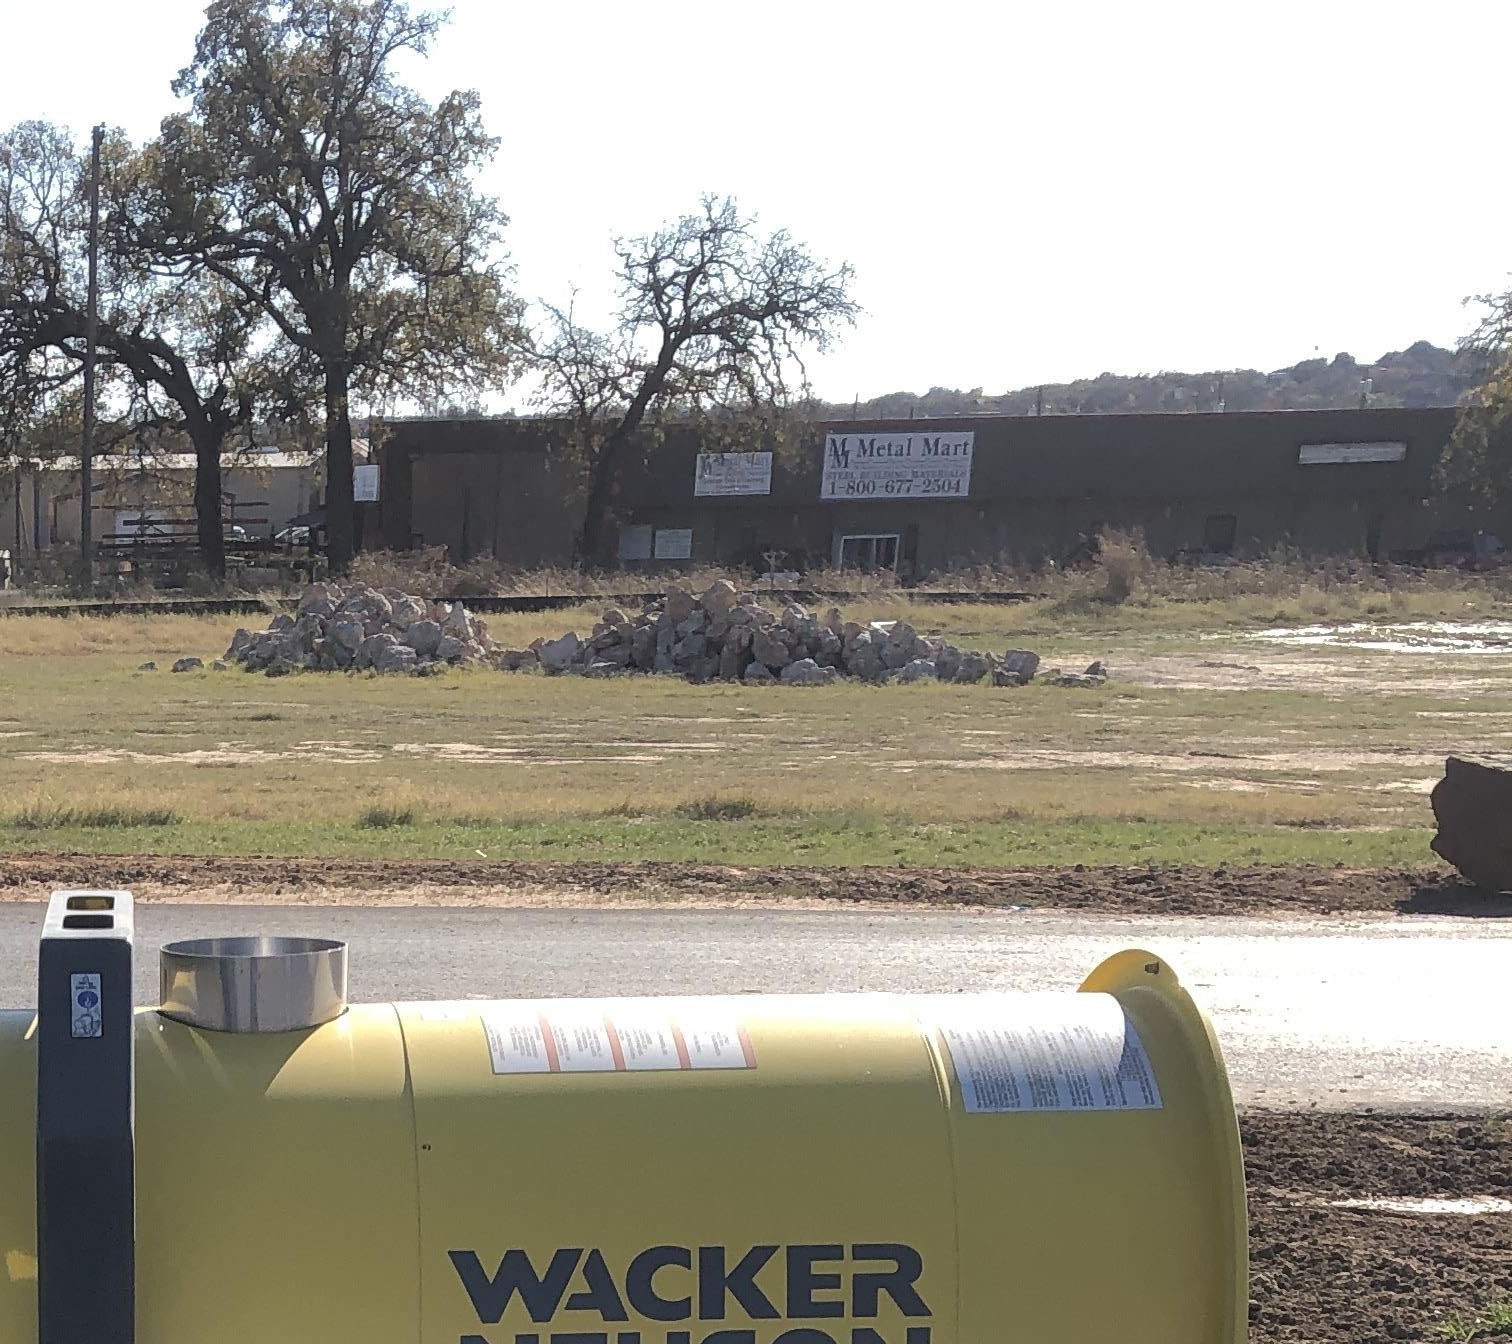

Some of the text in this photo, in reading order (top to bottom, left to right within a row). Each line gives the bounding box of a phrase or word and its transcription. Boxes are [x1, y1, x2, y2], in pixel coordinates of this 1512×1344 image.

[857, 437, 970, 458] Metal Mart
[448, 1243, 933, 1324] WACKER
